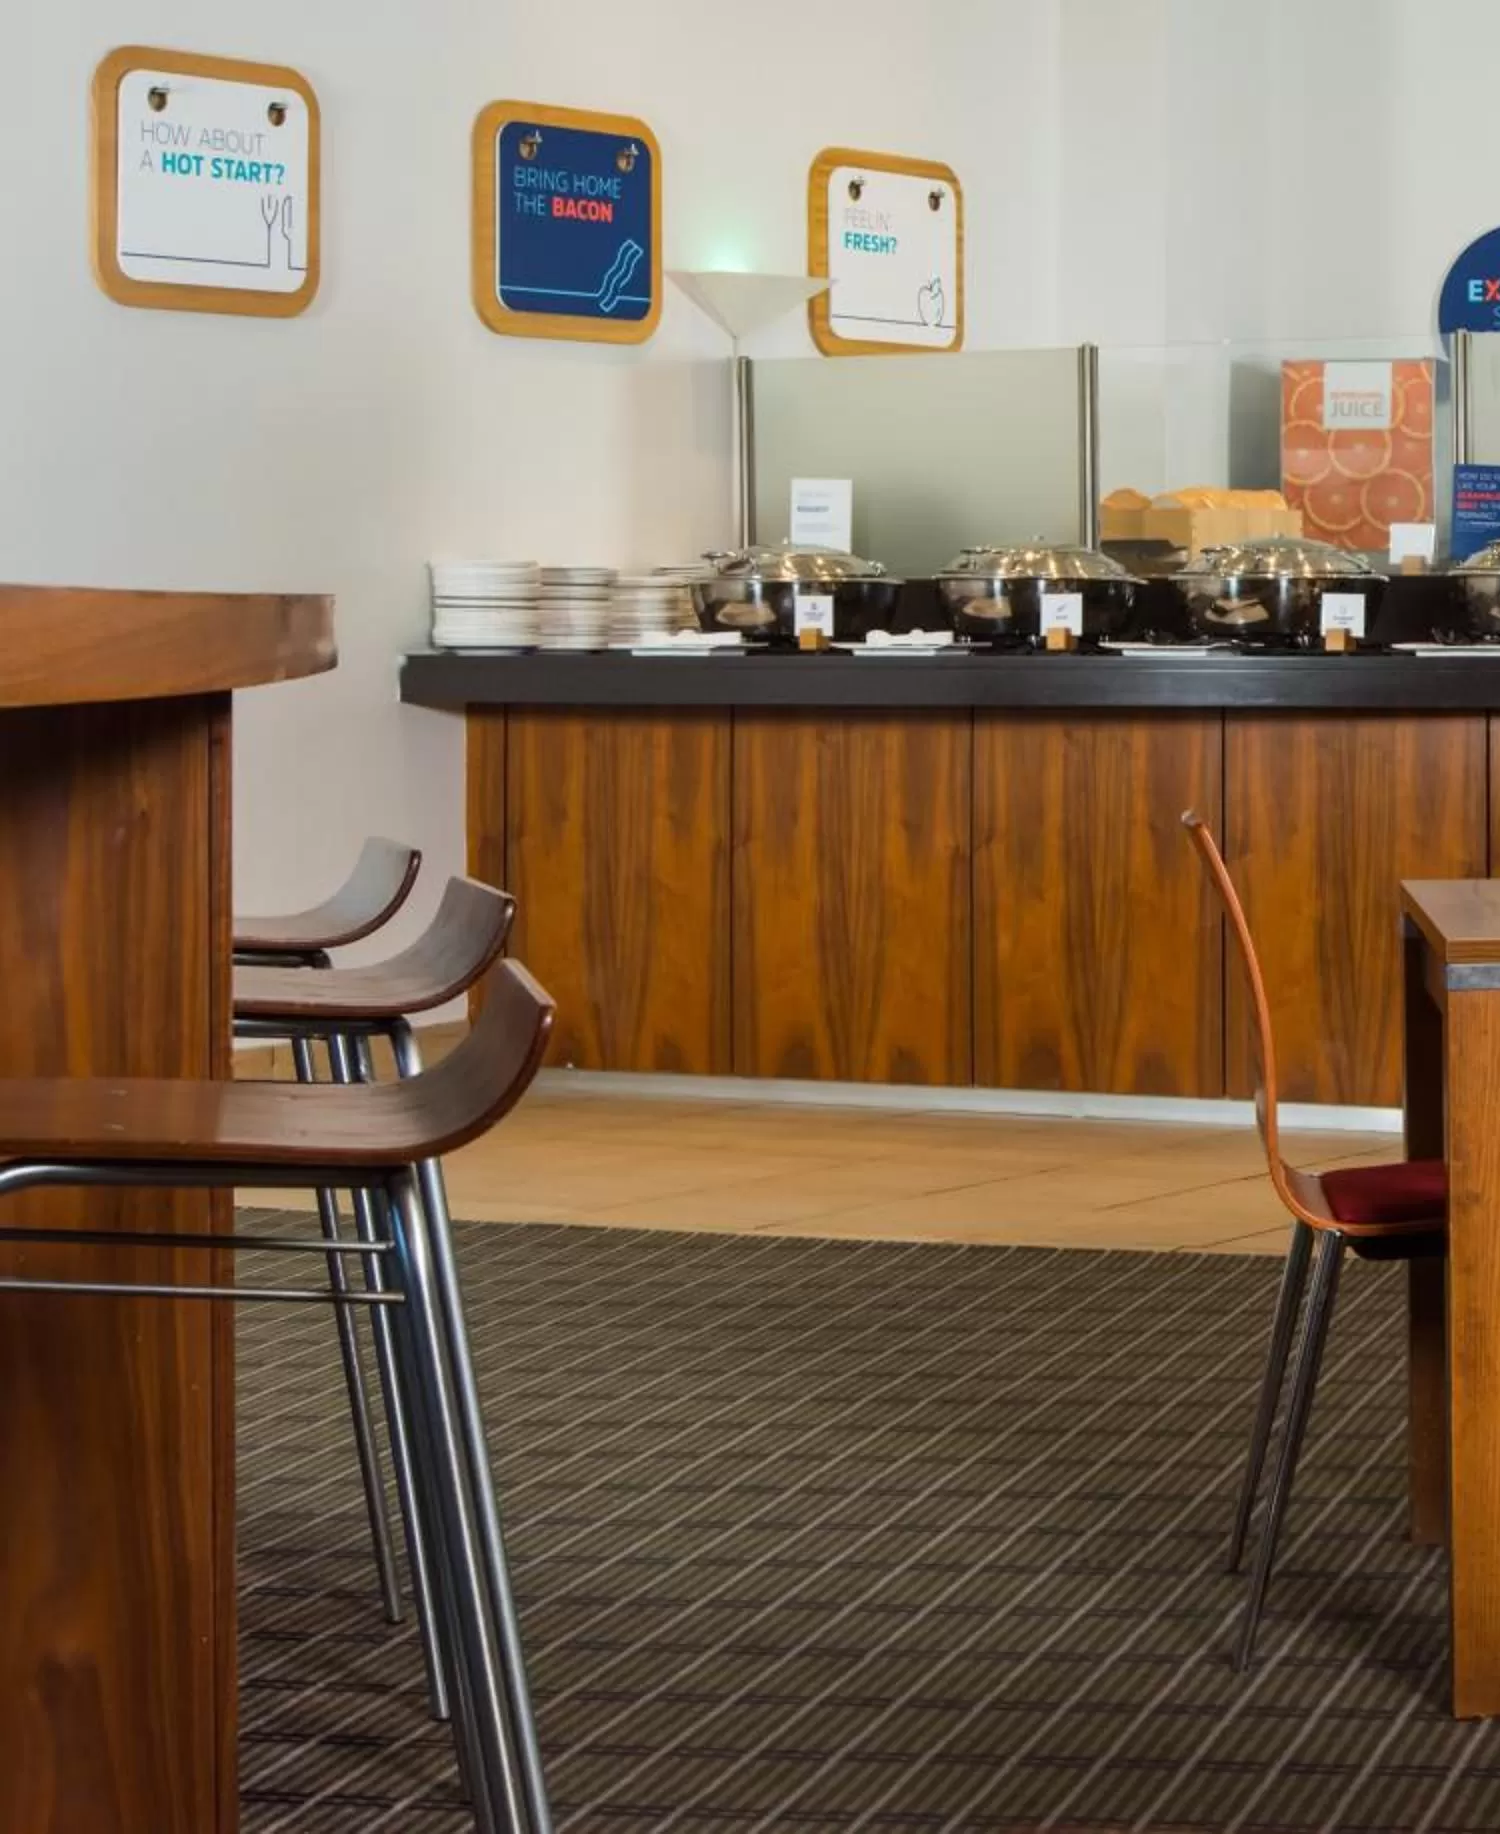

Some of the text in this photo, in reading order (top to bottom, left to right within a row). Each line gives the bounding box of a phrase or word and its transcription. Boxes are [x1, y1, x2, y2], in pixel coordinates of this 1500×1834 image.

[140, 120, 265, 156] HOW ABOUT
[140, 150, 285, 185] A HOT START?
[513, 166, 622, 199] BRING HOME
[514, 192, 613, 224] THE BACON
[844, 232, 897, 254] FRESH?
[1330, 401, 1384, 418] JUICE
